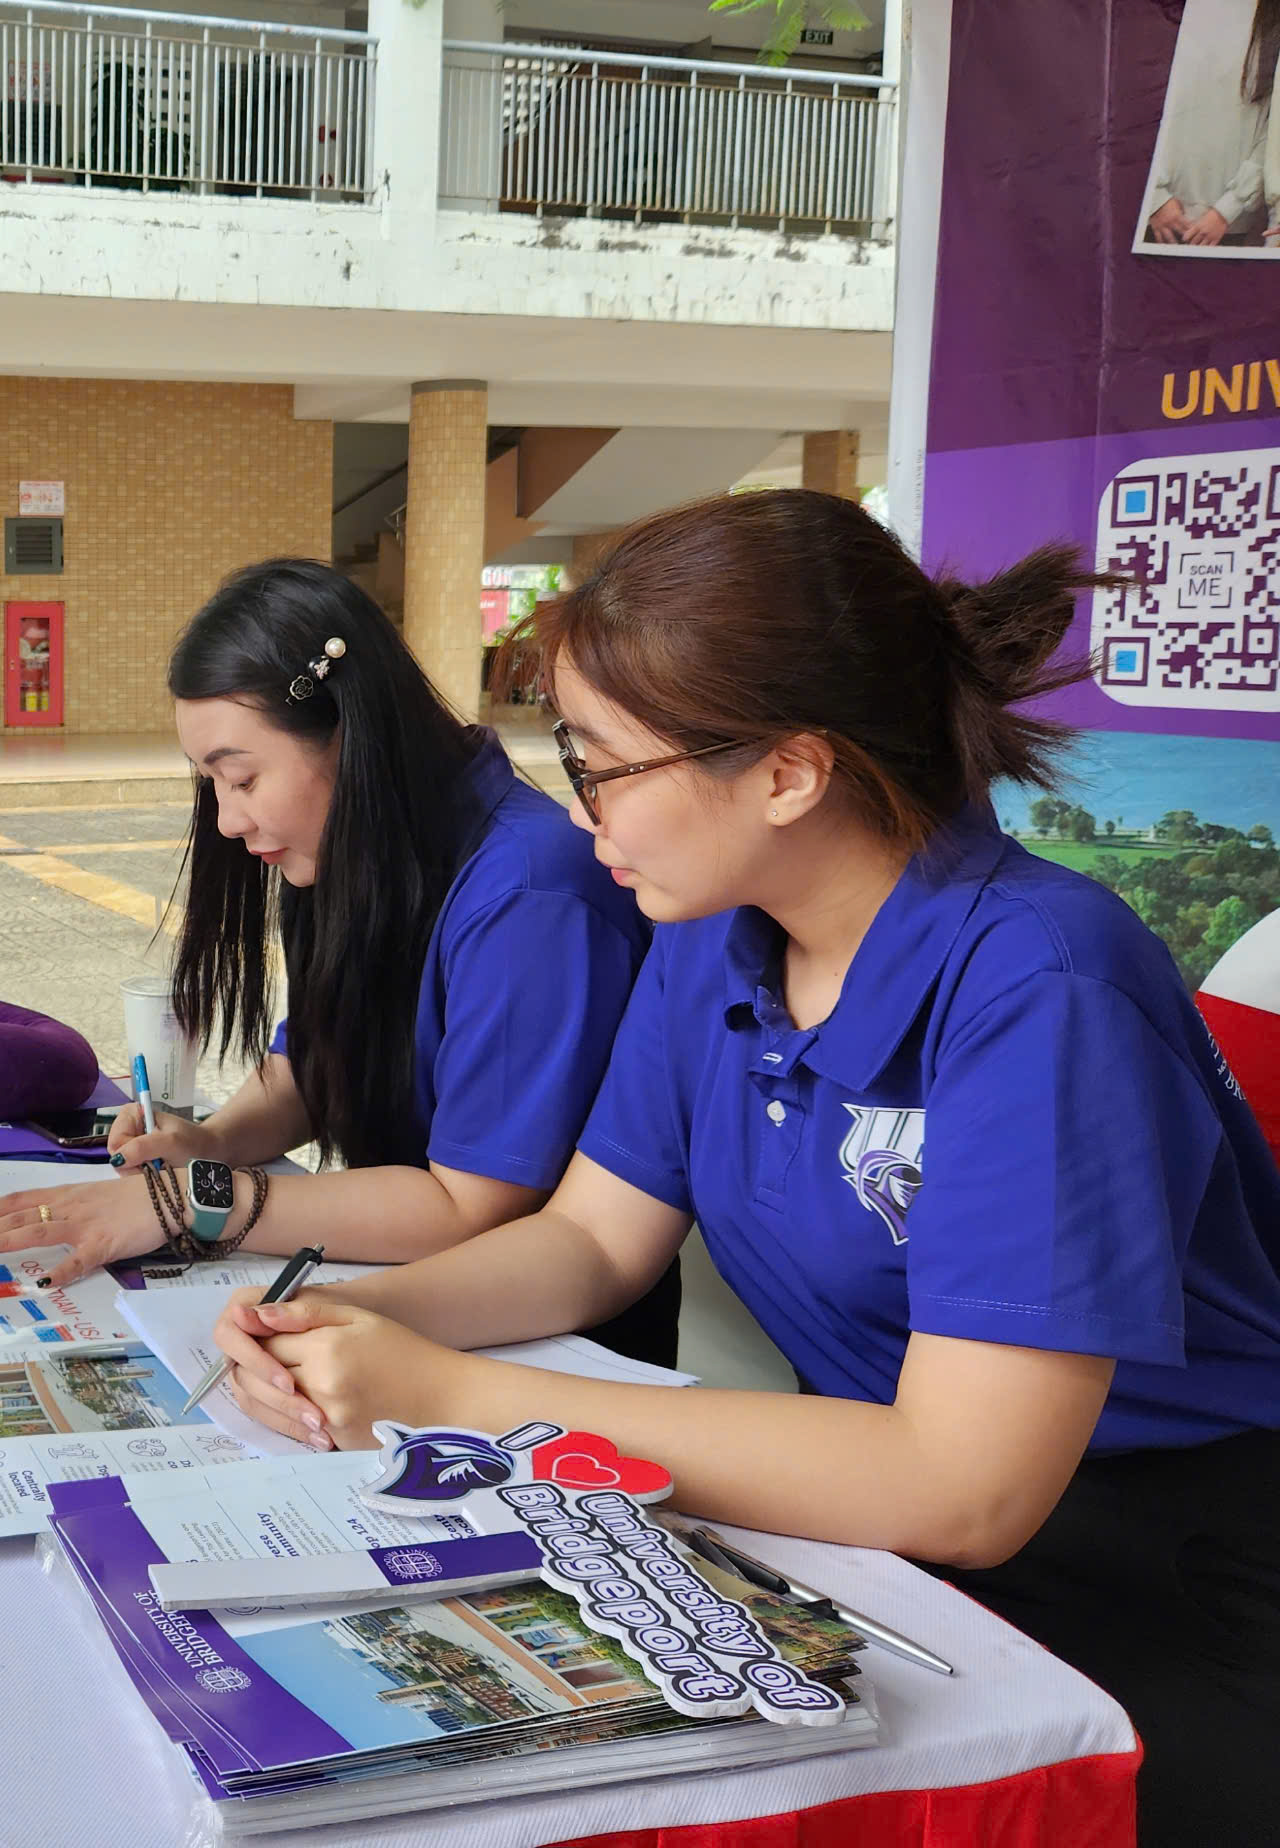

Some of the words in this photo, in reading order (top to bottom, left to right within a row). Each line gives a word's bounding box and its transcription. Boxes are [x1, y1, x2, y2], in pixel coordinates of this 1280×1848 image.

[805, 31, 832, 45] EXIT
[1190, 564, 1223, 576] SCAN
[1188, 579, 1221, 596] ME
[498, 1423, 561, 1449] I
[8, 1471, 28, 1497] located
[22, 1470, 45, 1502] Centrally
[346, 1518, 367, 1536] 124
[133, 1592, 153, 1606] OF
[503, 1484, 738, 1701] Bridgeport
[579, 1493, 769, 1659] University
[746, 1662, 836, 1708] of
[144, 1607, 204, 1668] UNIVERSITY
